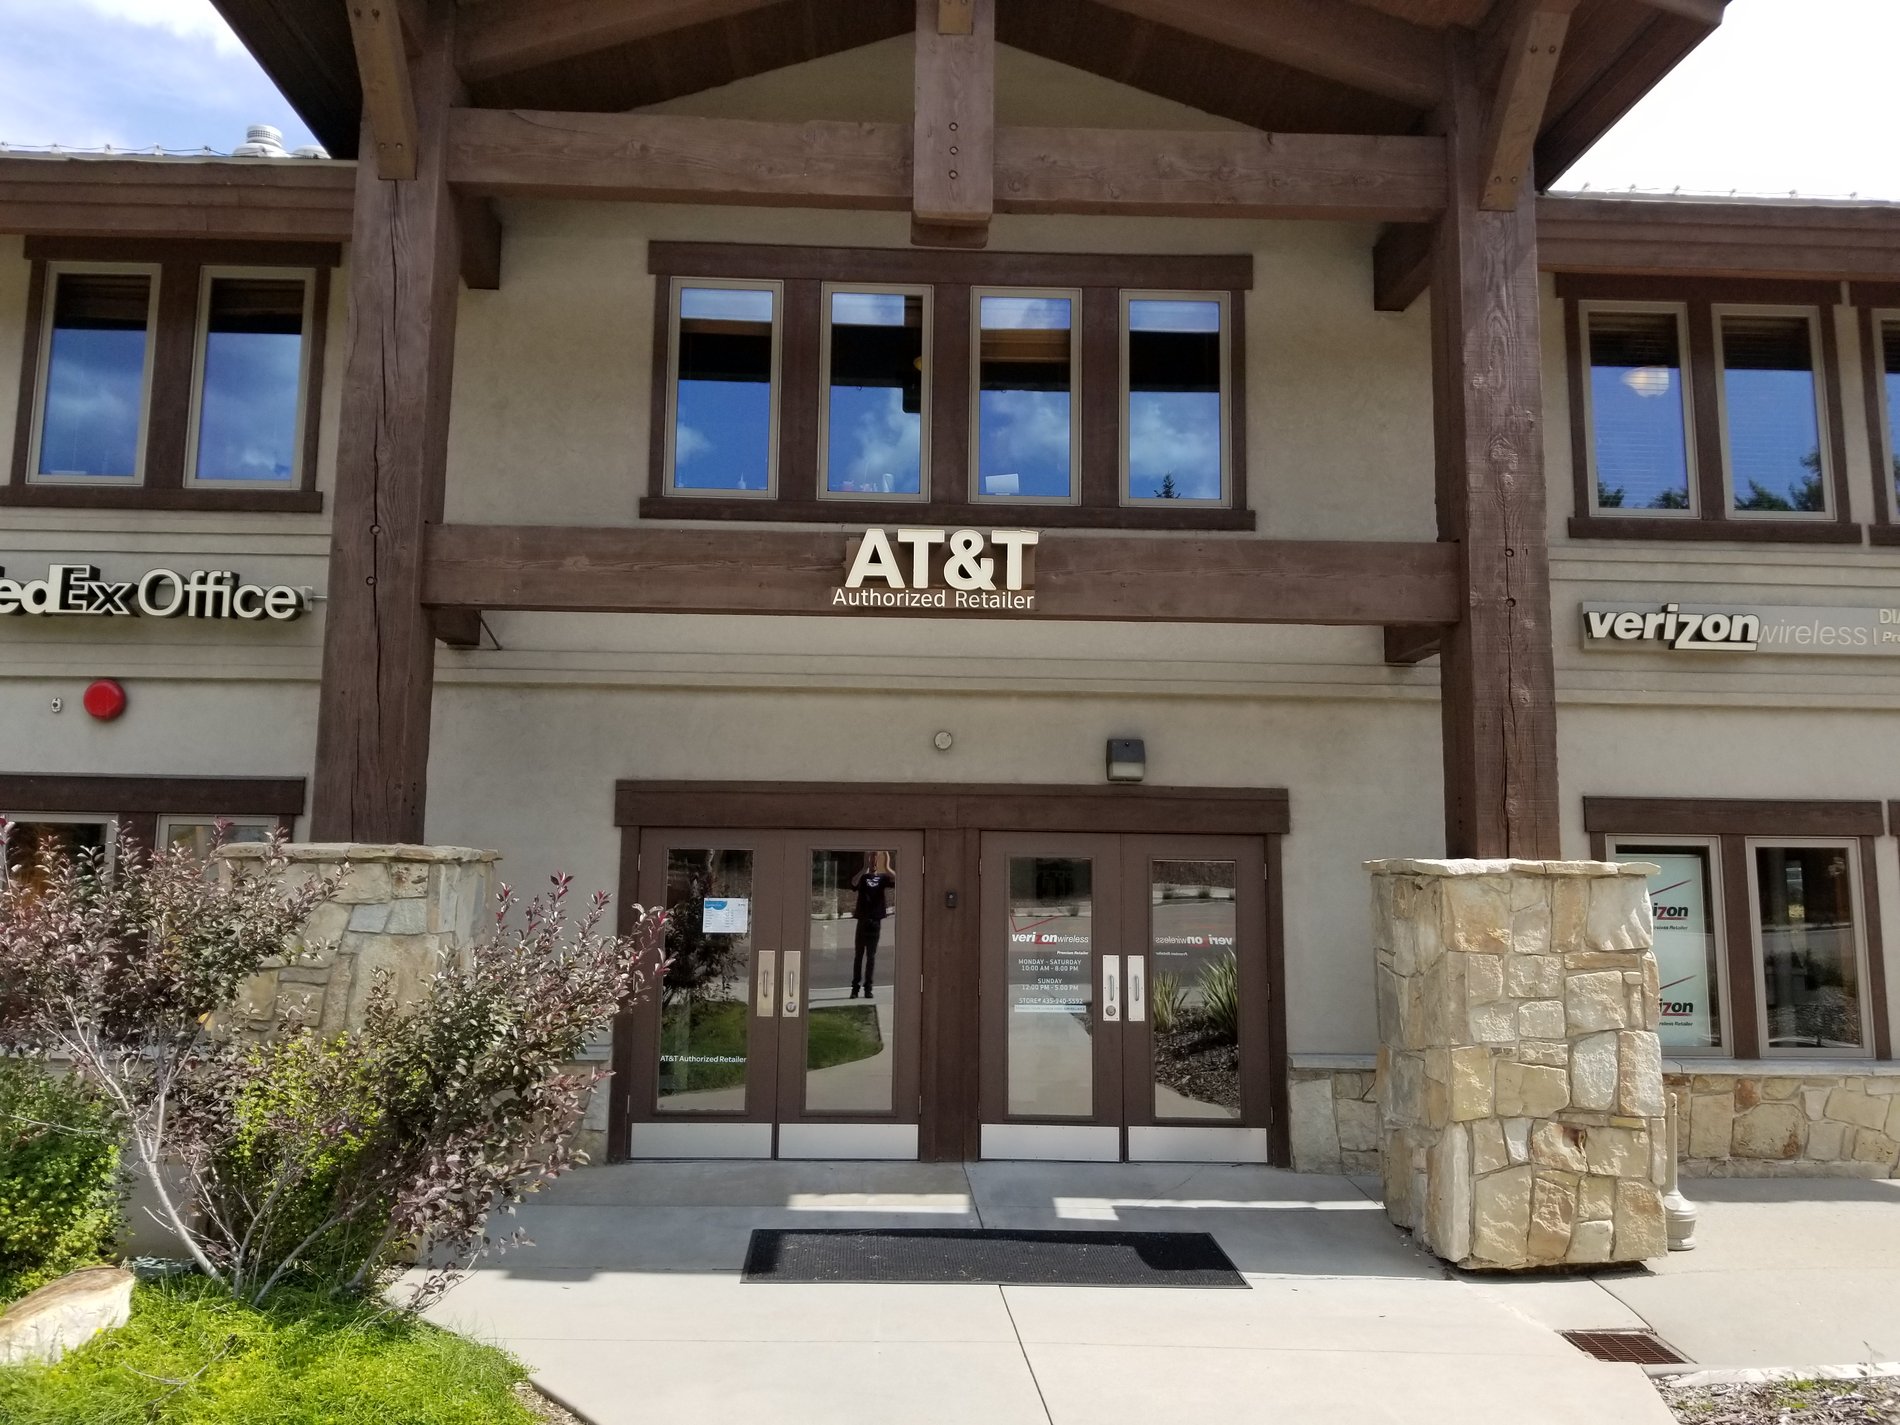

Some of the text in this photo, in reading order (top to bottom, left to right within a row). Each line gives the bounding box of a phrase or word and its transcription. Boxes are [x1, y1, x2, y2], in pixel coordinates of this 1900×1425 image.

[845, 528, 1039, 591] AT&T
[0, 564, 299, 619] edEx Office
[832, 588, 1035, 609] Authorized Retailer
[1652, 902, 1689, 921] izon
[1659, 998, 1694, 1017] izon
